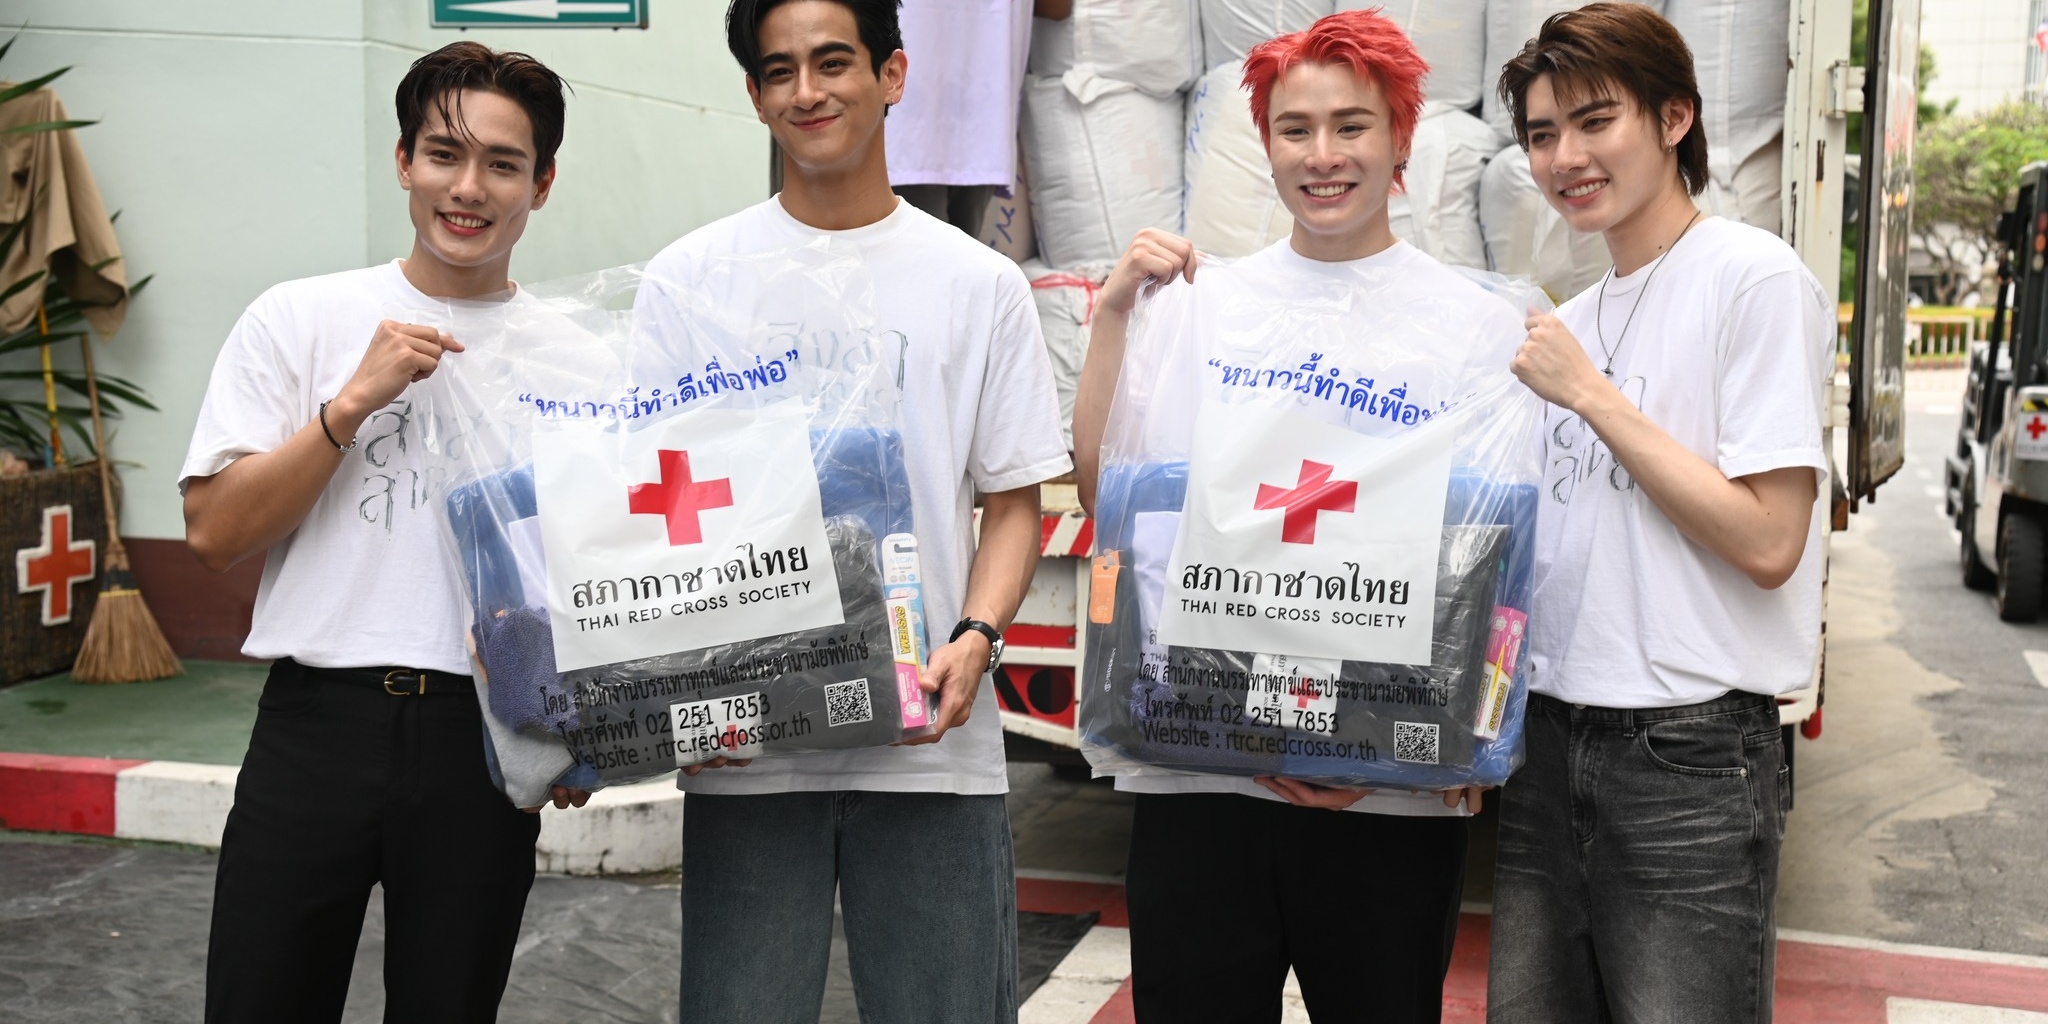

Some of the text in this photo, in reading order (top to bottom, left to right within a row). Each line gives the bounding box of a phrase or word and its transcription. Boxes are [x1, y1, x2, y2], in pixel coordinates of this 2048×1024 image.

[572, 542, 810, 609] สภากาชาดไทย
[1182, 562, 1410, 605] สภากาชาดไทย
[577, 580, 812, 632] THAI RED CROSS SOCIETY
[1181, 599, 1407, 629] THAI RED CROSS SOCIETY
[895, 606, 911, 655] SYSTEMA
[1138, 652, 1158, 681] โดย
[540, 686, 568, 715] โดย
[557, 693, 770, 747] โทรศัพท์ 02 251 7853
[1144, 688, 1340, 734] โทรศัพท์ 02 251 7853
[656, 711, 811, 760] rtrc.redcross.or.th
[1142, 720, 1210, 746] Website
[1226, 728, 1377, 762] rtrc.redcross.or.th
